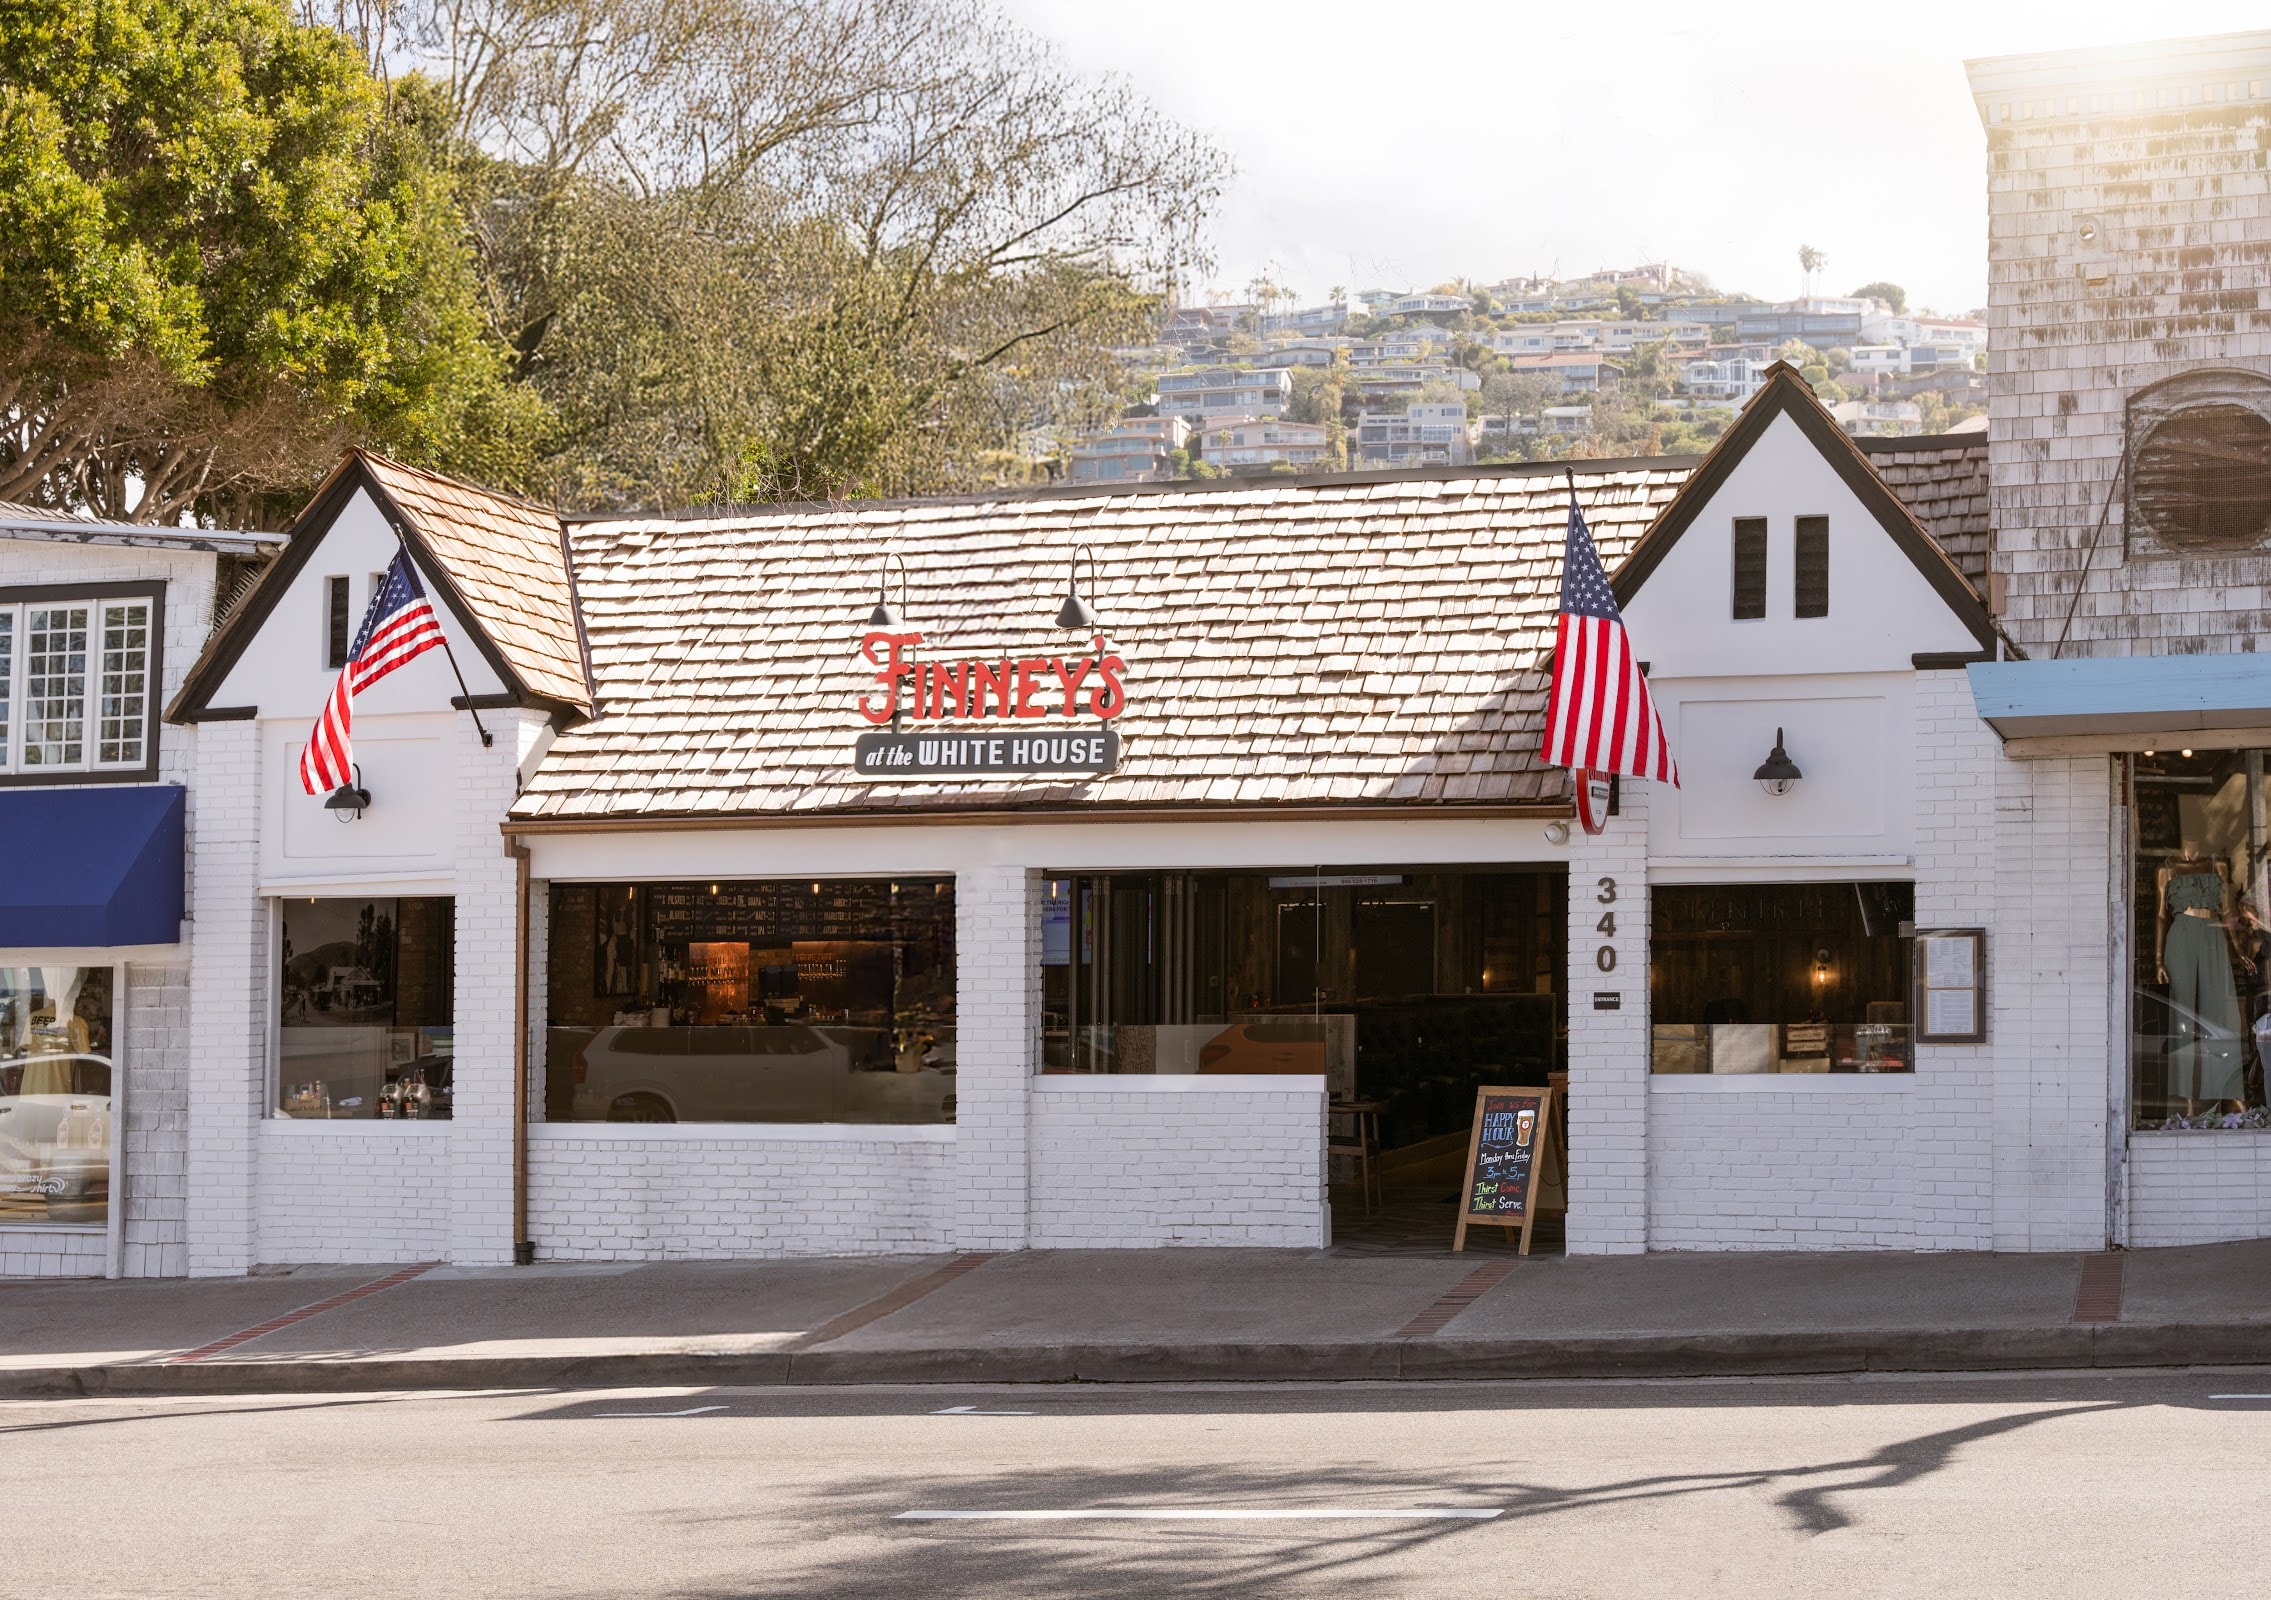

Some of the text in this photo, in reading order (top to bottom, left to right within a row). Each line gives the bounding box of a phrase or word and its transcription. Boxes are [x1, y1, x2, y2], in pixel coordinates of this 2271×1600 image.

[865, 738, 1105, 766] at the WHITE HOUSE
[1509, 1101, 1520, 1109] us
[1521, 1099, 1537, 1109] for
[1484, 1112, 1517, 1128] HAPPY
[1482, 1127, 1515, 1141] HOUR
[1480, 1153, 1504, 1166] Monday
[1514, 1149, 1531, 1163] Friday
[1476, 1182, 1499, 1194] Thirst
[1473, 1196, 1523, 1210] Thirst Serve.
